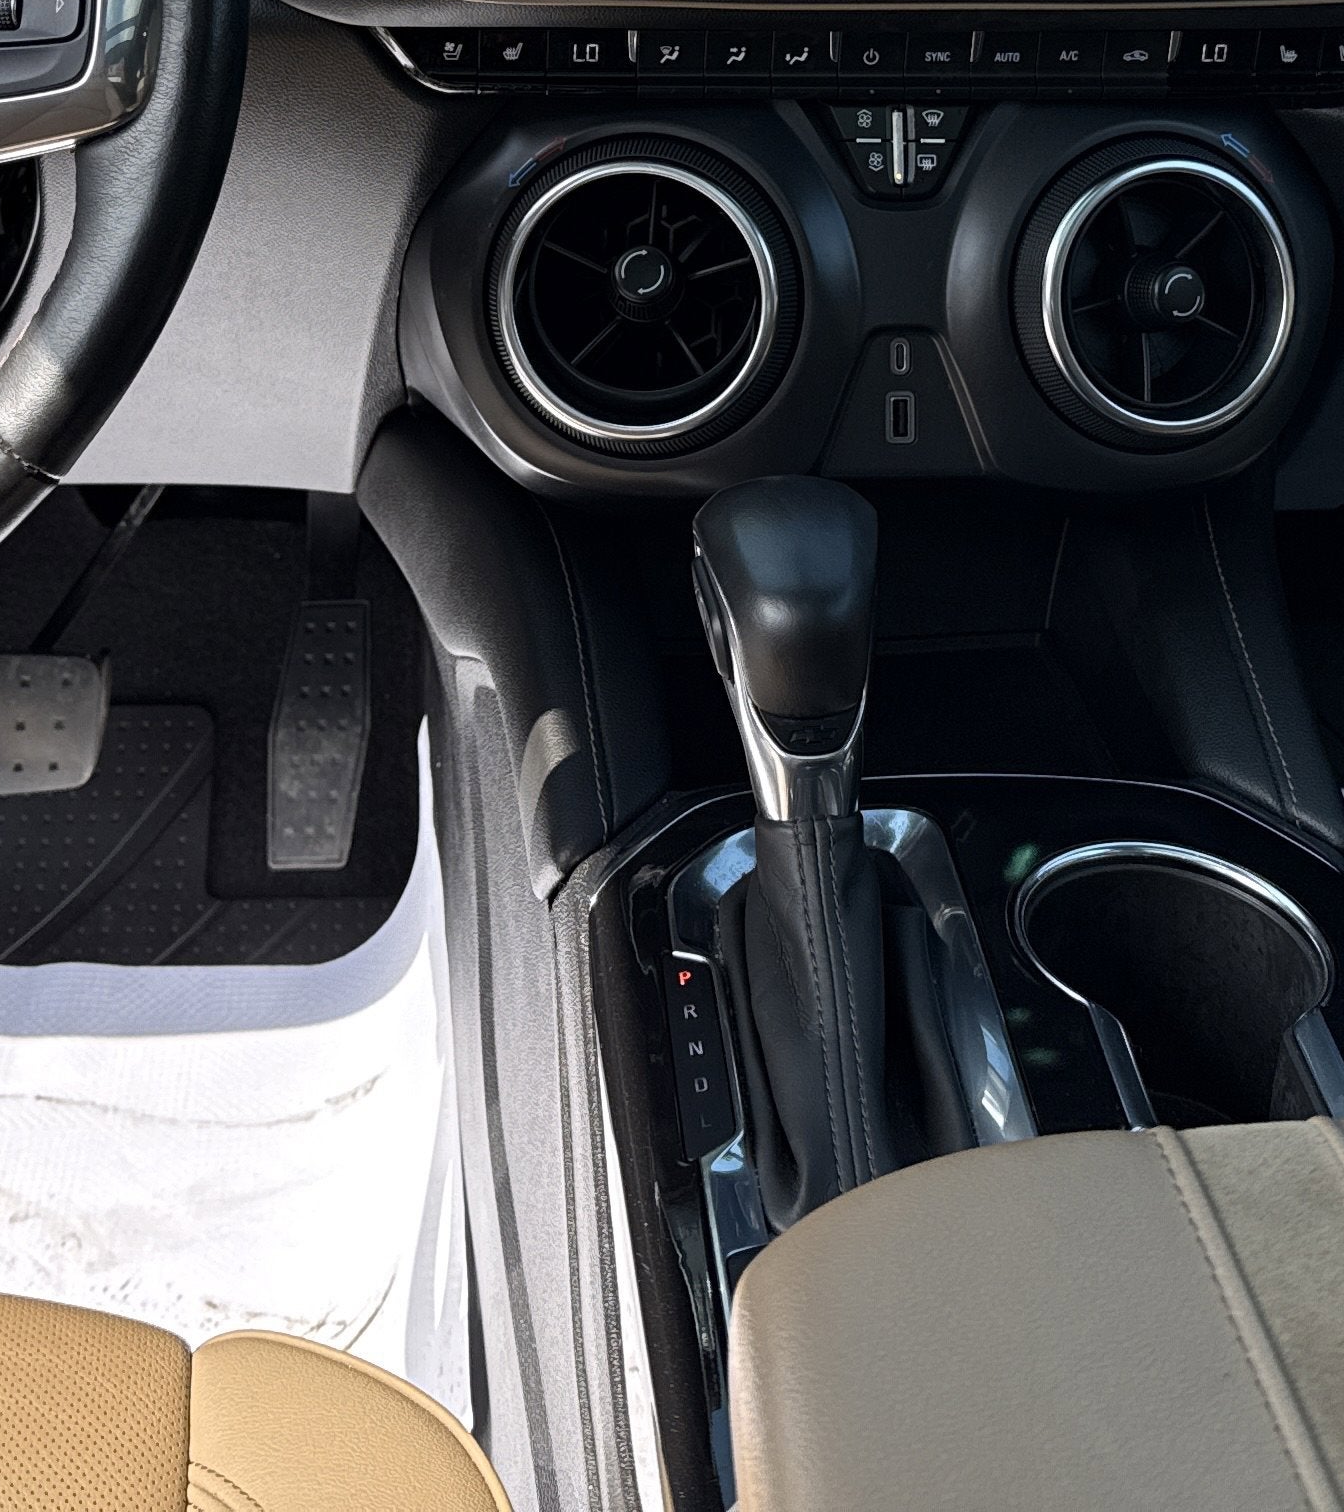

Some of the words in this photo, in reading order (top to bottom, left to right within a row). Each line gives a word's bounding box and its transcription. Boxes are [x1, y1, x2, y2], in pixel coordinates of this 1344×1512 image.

[573, 43, 599, 63] LO
[924, 51, 951, 62] SYNC
[994, 52, 1020, 62] AUTO
[1059, 50, 1079, 61] A/C
[1201, 43, 1228, 63] LO
[678, 970, 692, 986] P
[683, 1003, 698, 1020] R
[688, 1040, 704, 1057] N
[694, 1077, 709, 1093] D
